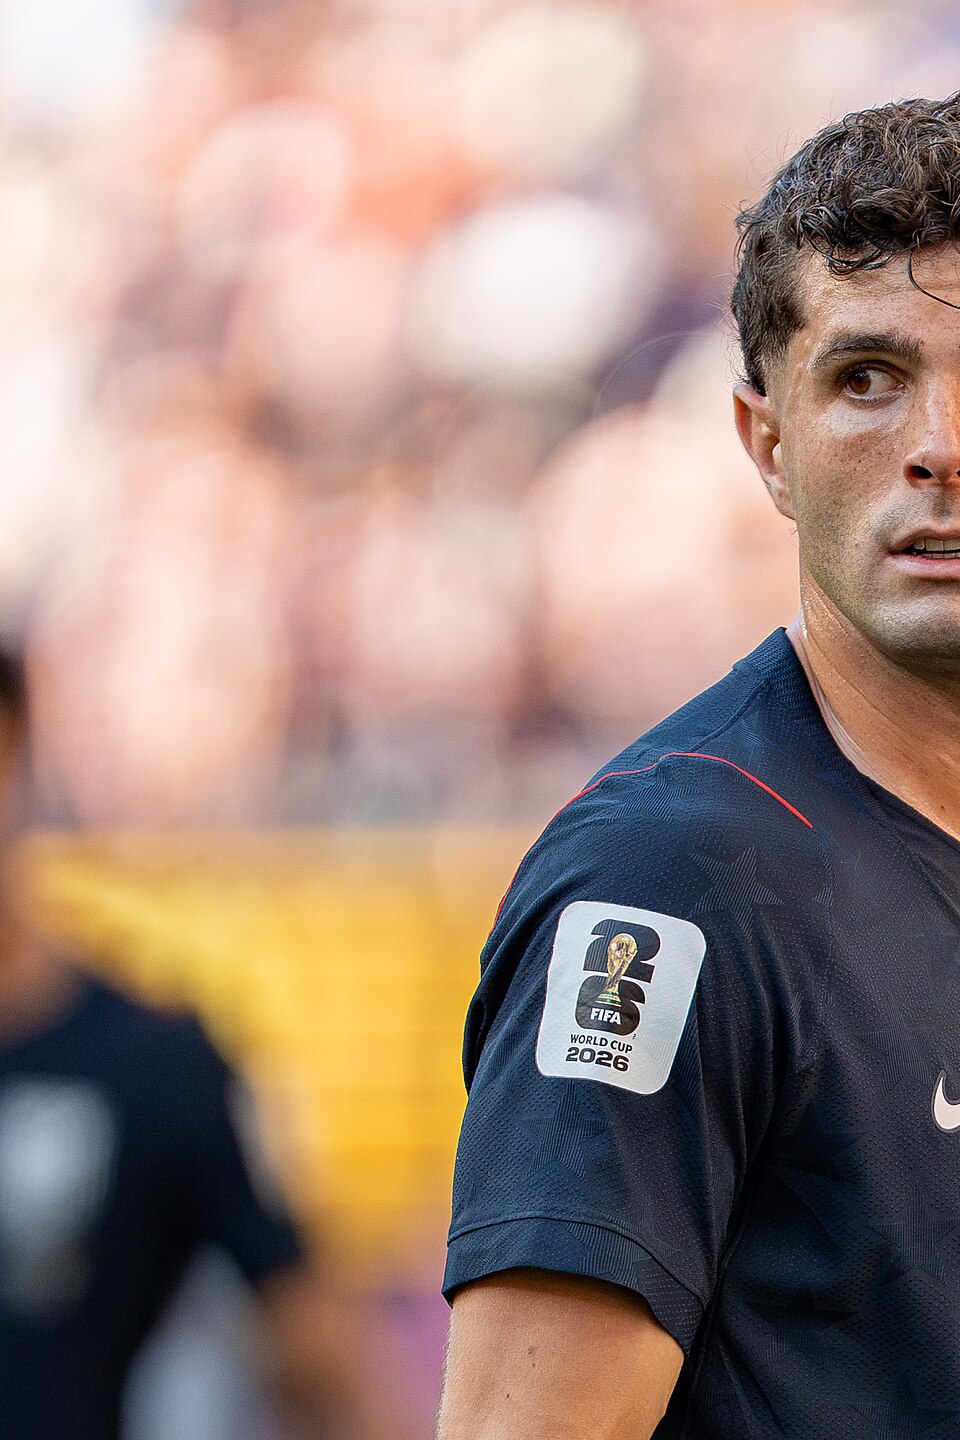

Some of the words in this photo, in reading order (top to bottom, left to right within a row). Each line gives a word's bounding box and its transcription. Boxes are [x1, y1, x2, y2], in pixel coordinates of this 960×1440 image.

[590, 1007, 622, 1025] FIFA
[570, 1033, 608, 1047] WORLD
[610, 1040, 633, 1053] CUP
[565, 1046, 630, 1072] 2026
